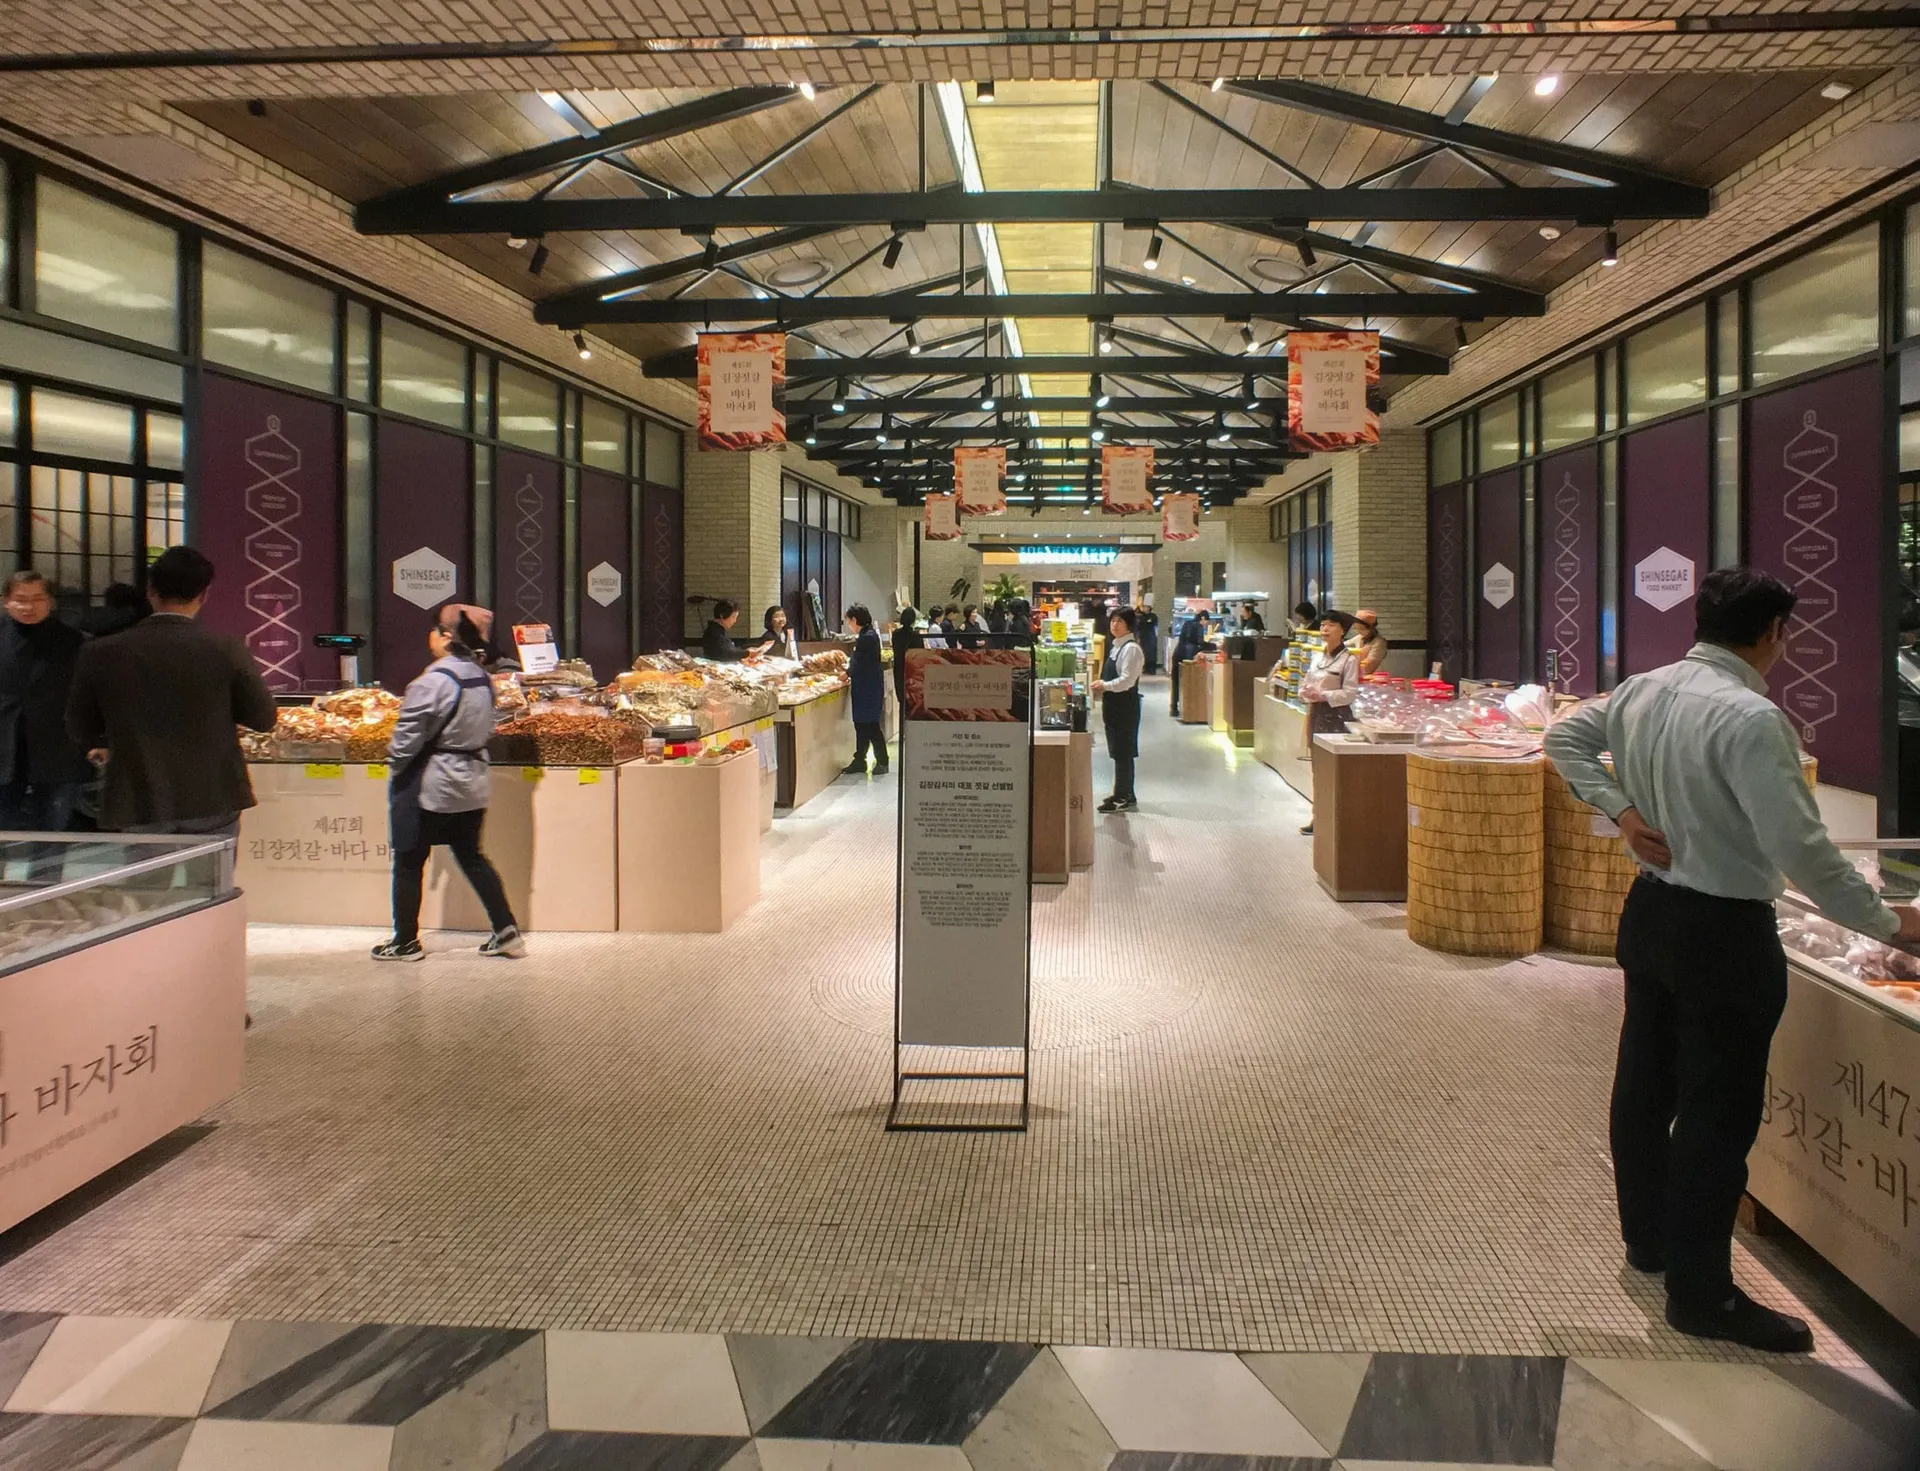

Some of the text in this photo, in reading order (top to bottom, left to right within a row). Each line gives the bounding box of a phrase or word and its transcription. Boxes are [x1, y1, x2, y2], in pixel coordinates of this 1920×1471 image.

[1323, 388, 1345, 398] 바다
[400, 568, 451, 581] SHINSEGAE
[1640, 569, 1688, 582] SHINSEGAE
[1661, 583, 1682, 591] MARKET
[919, 780, 955, 790] 김장김치의
[957, 781, 973, 790] 대표
[974, 781, 990, 791] 젓갈
[313, 816, 364, 835] 제47회
[33, 1024, 158, 1117] 바자회
[1831, 1060, 1920, 1140] 제47
